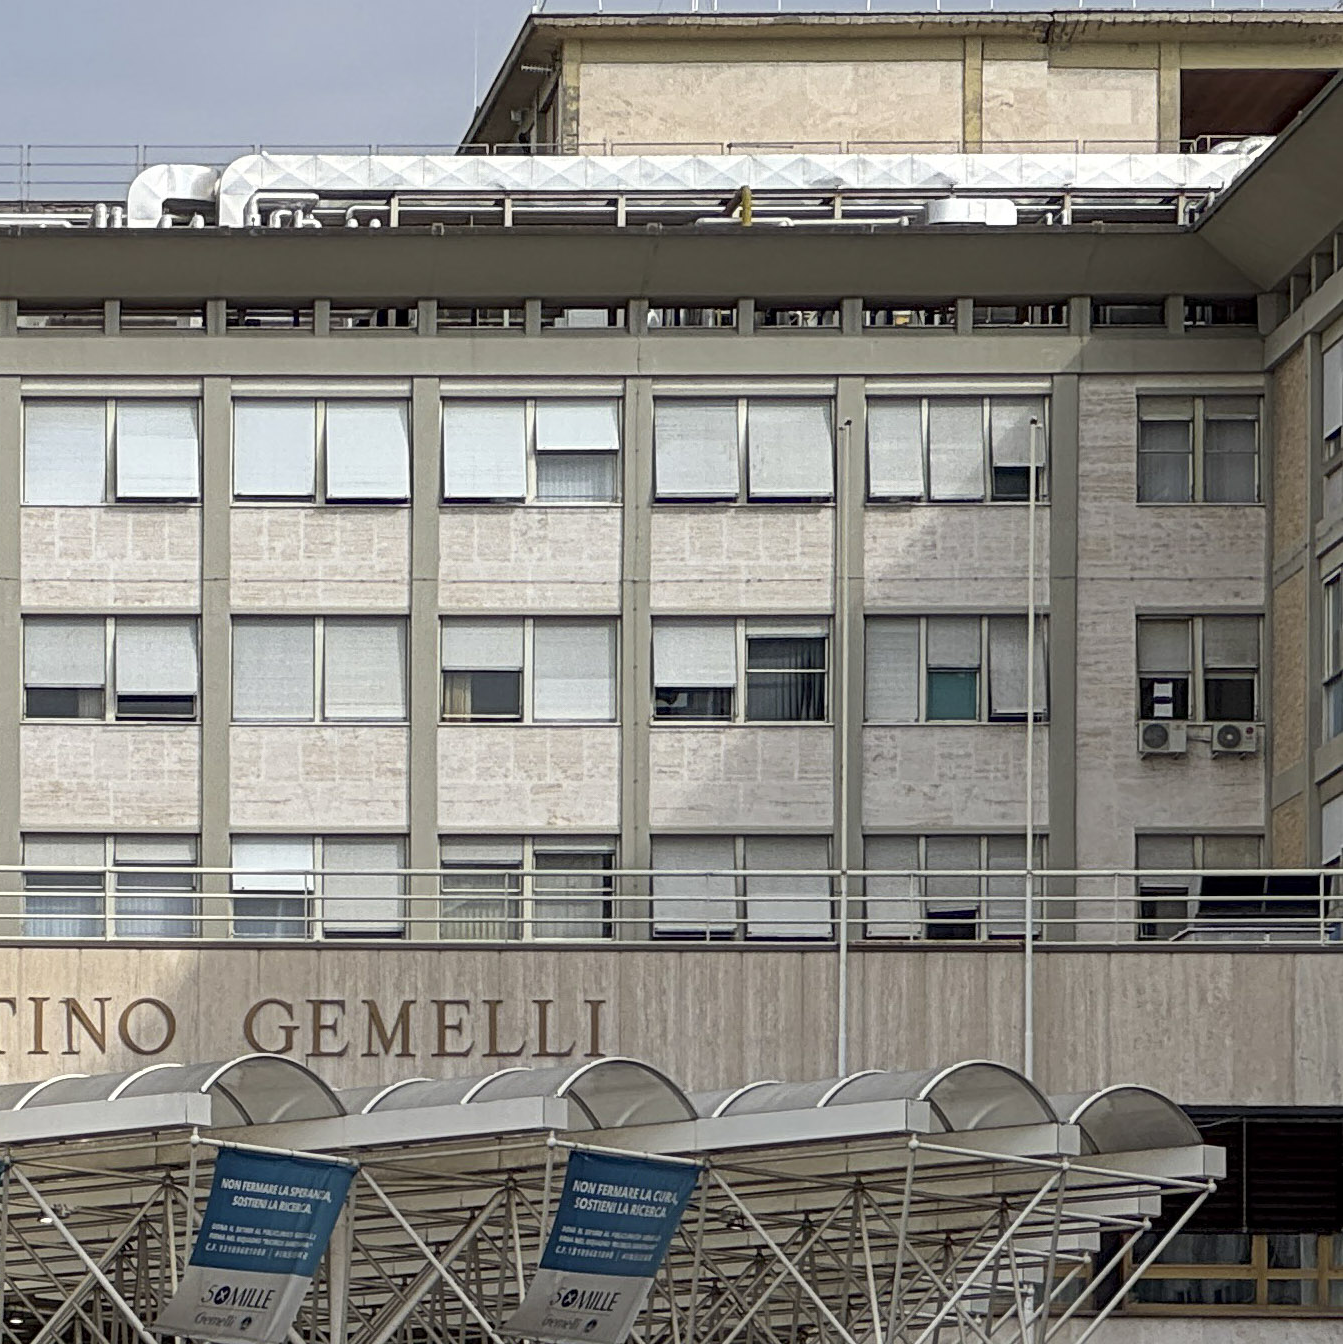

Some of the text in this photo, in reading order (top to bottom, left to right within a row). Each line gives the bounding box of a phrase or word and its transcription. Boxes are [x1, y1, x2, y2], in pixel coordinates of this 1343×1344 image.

[243, 998, 608, 1059] GEMELLI
[221, 1178, 242, 1191] NON
[242, 1180, 278, 1196] FERMARE
[278, 1185, 288, 1196] LA
[572, 1180, 595, 1194] NON
[596, 1184, 639, 1200] FERMARE
[639, 1188, 652, 1201] LA
[232, 1195, 268, 1209] SOSTIENI
[268, 1199, 278, 1210] LA
[574, 1197, 617, 1212] SOSTIENI
[617, 1203, 629, 1215] LA
